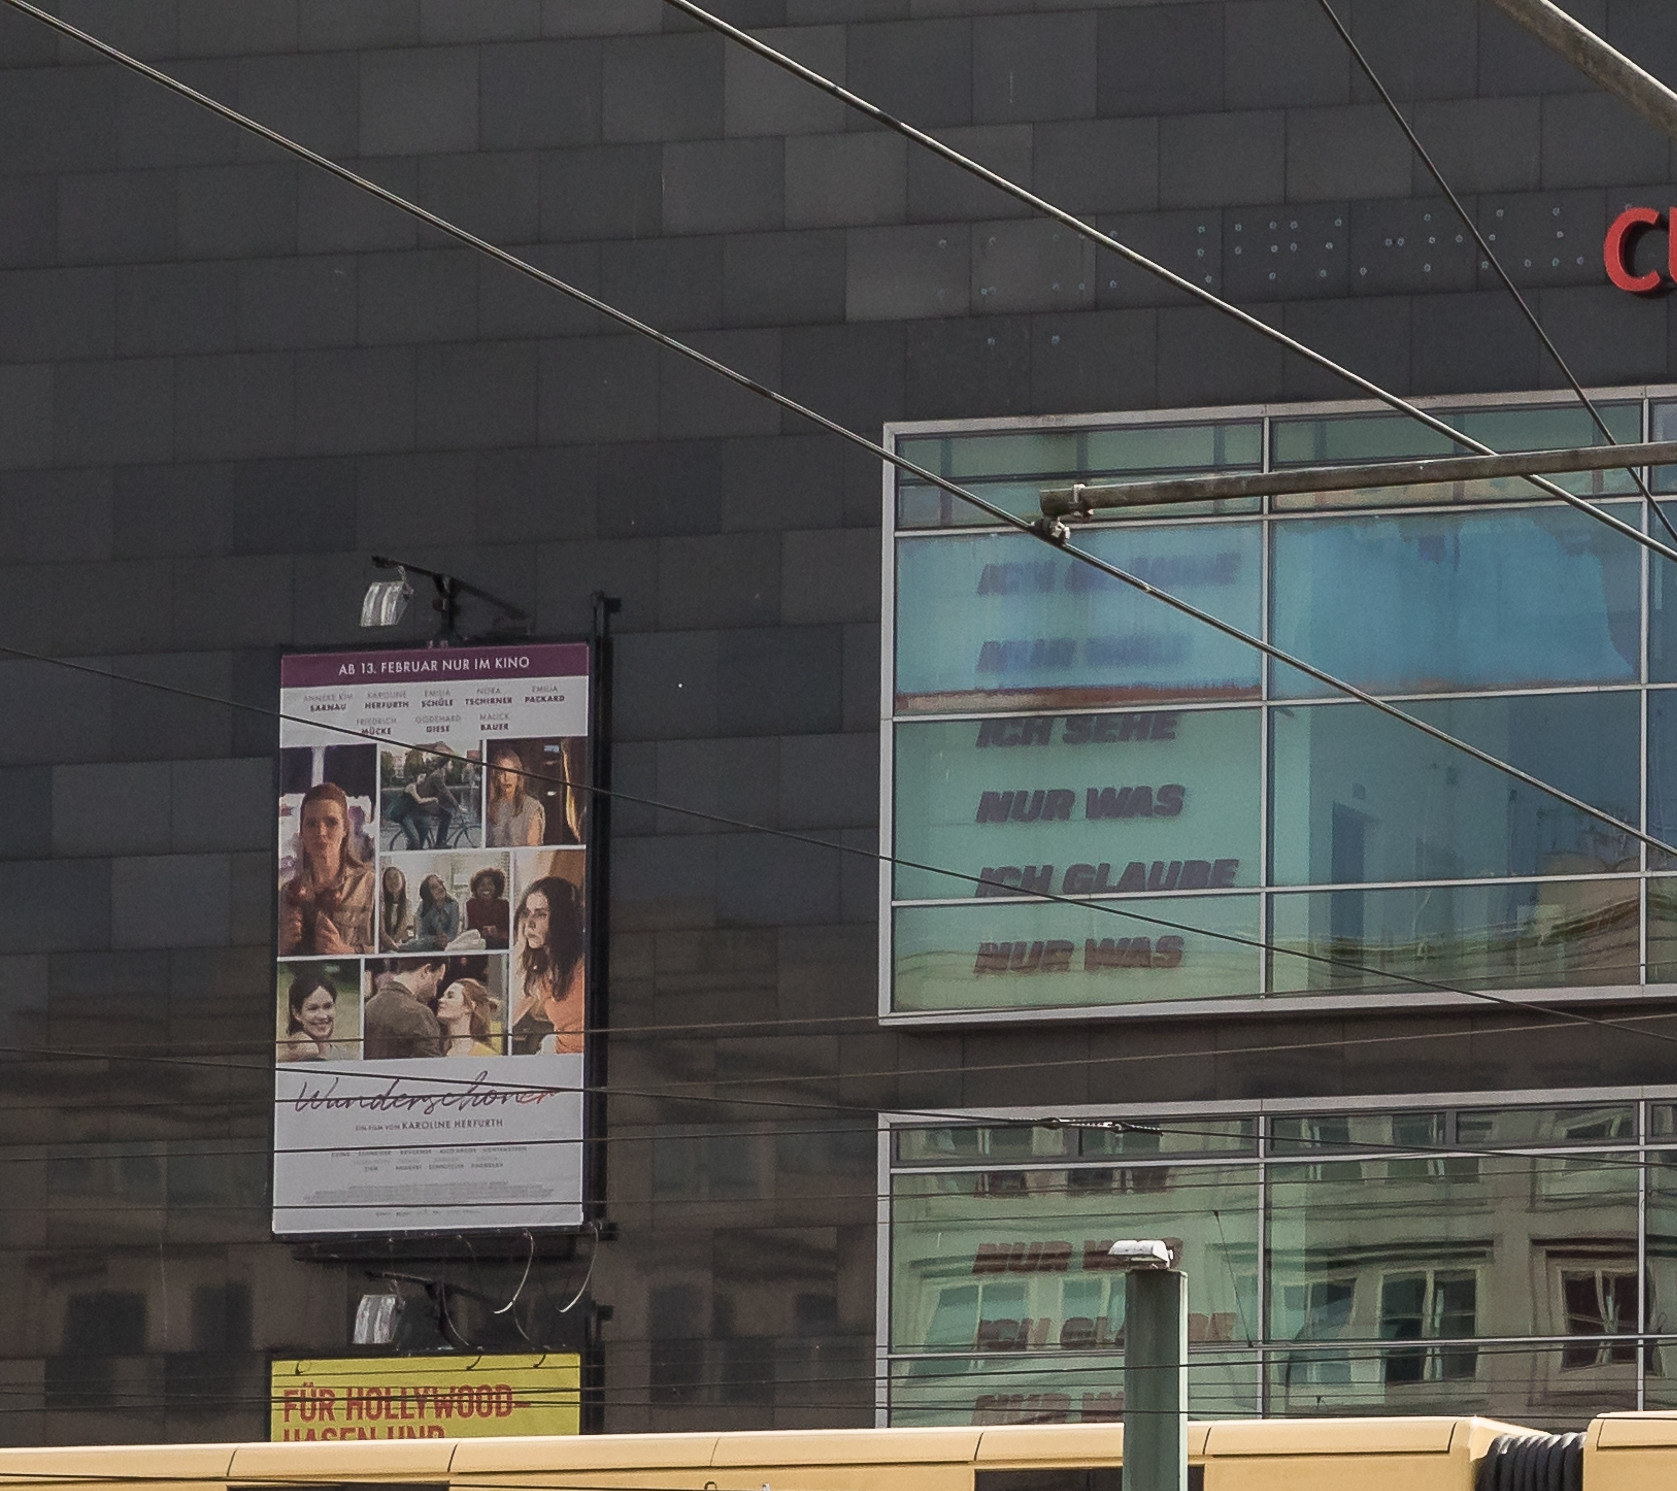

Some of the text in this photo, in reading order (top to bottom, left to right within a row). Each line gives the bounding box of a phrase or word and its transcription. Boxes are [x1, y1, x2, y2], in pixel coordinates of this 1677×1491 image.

[339, 655, 531, 676] AB 13. FEBRUAR NUR IM KINO
[366, 701, 410, 710] HERFURTH
[525, 695, 566, 704] PACKARD
[976, 784, 1186, 823] NUR WAS
[1062, 859, 1240, 894] GLAUBE
[402, 1118, 451, 1131] KAROLINE
[454, 1117, 504, 1129] HERFURTH
[284, 1380, 336, 1422] FÜR
